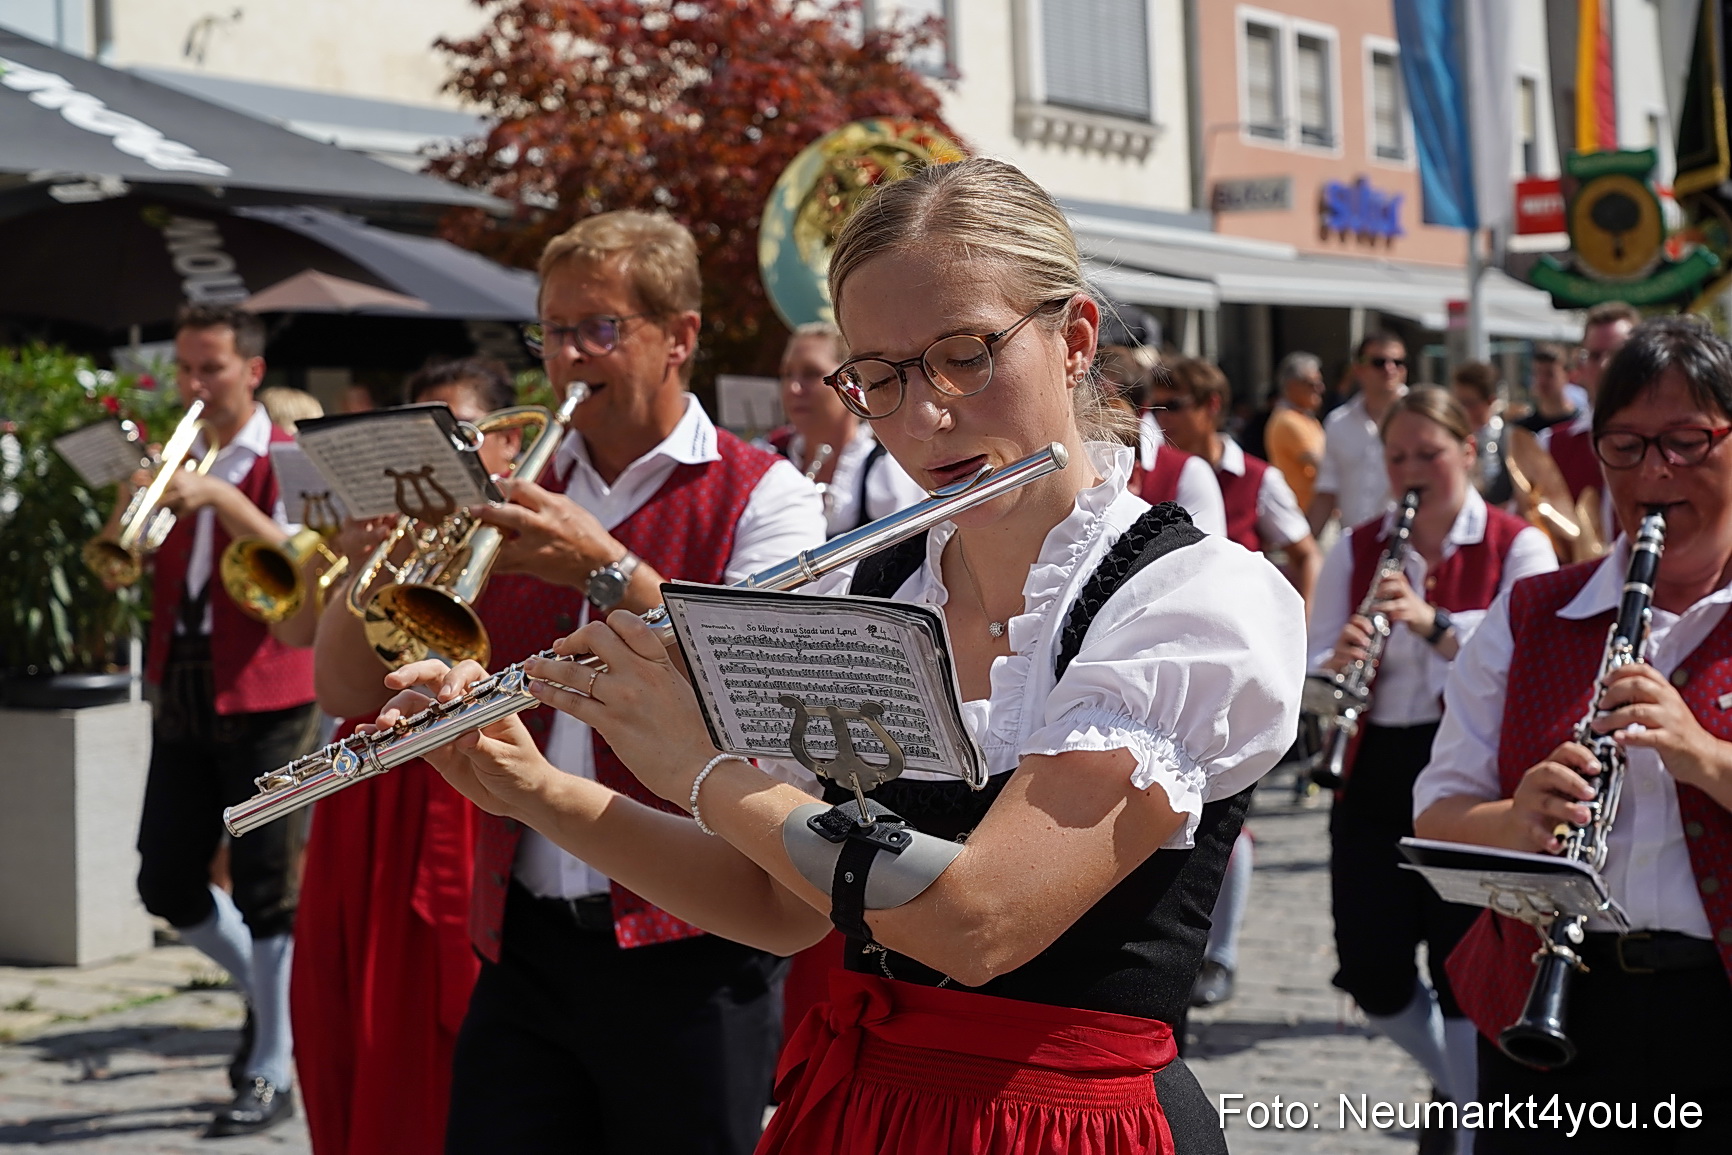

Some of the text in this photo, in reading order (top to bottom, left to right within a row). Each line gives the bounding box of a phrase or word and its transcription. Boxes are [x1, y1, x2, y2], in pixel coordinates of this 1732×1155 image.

[746, 623, 757, 632] So
[799, 626, 819, 635] Stadt
[819, 627, 835, 635] und
[837, 627, 858, 637] Land
